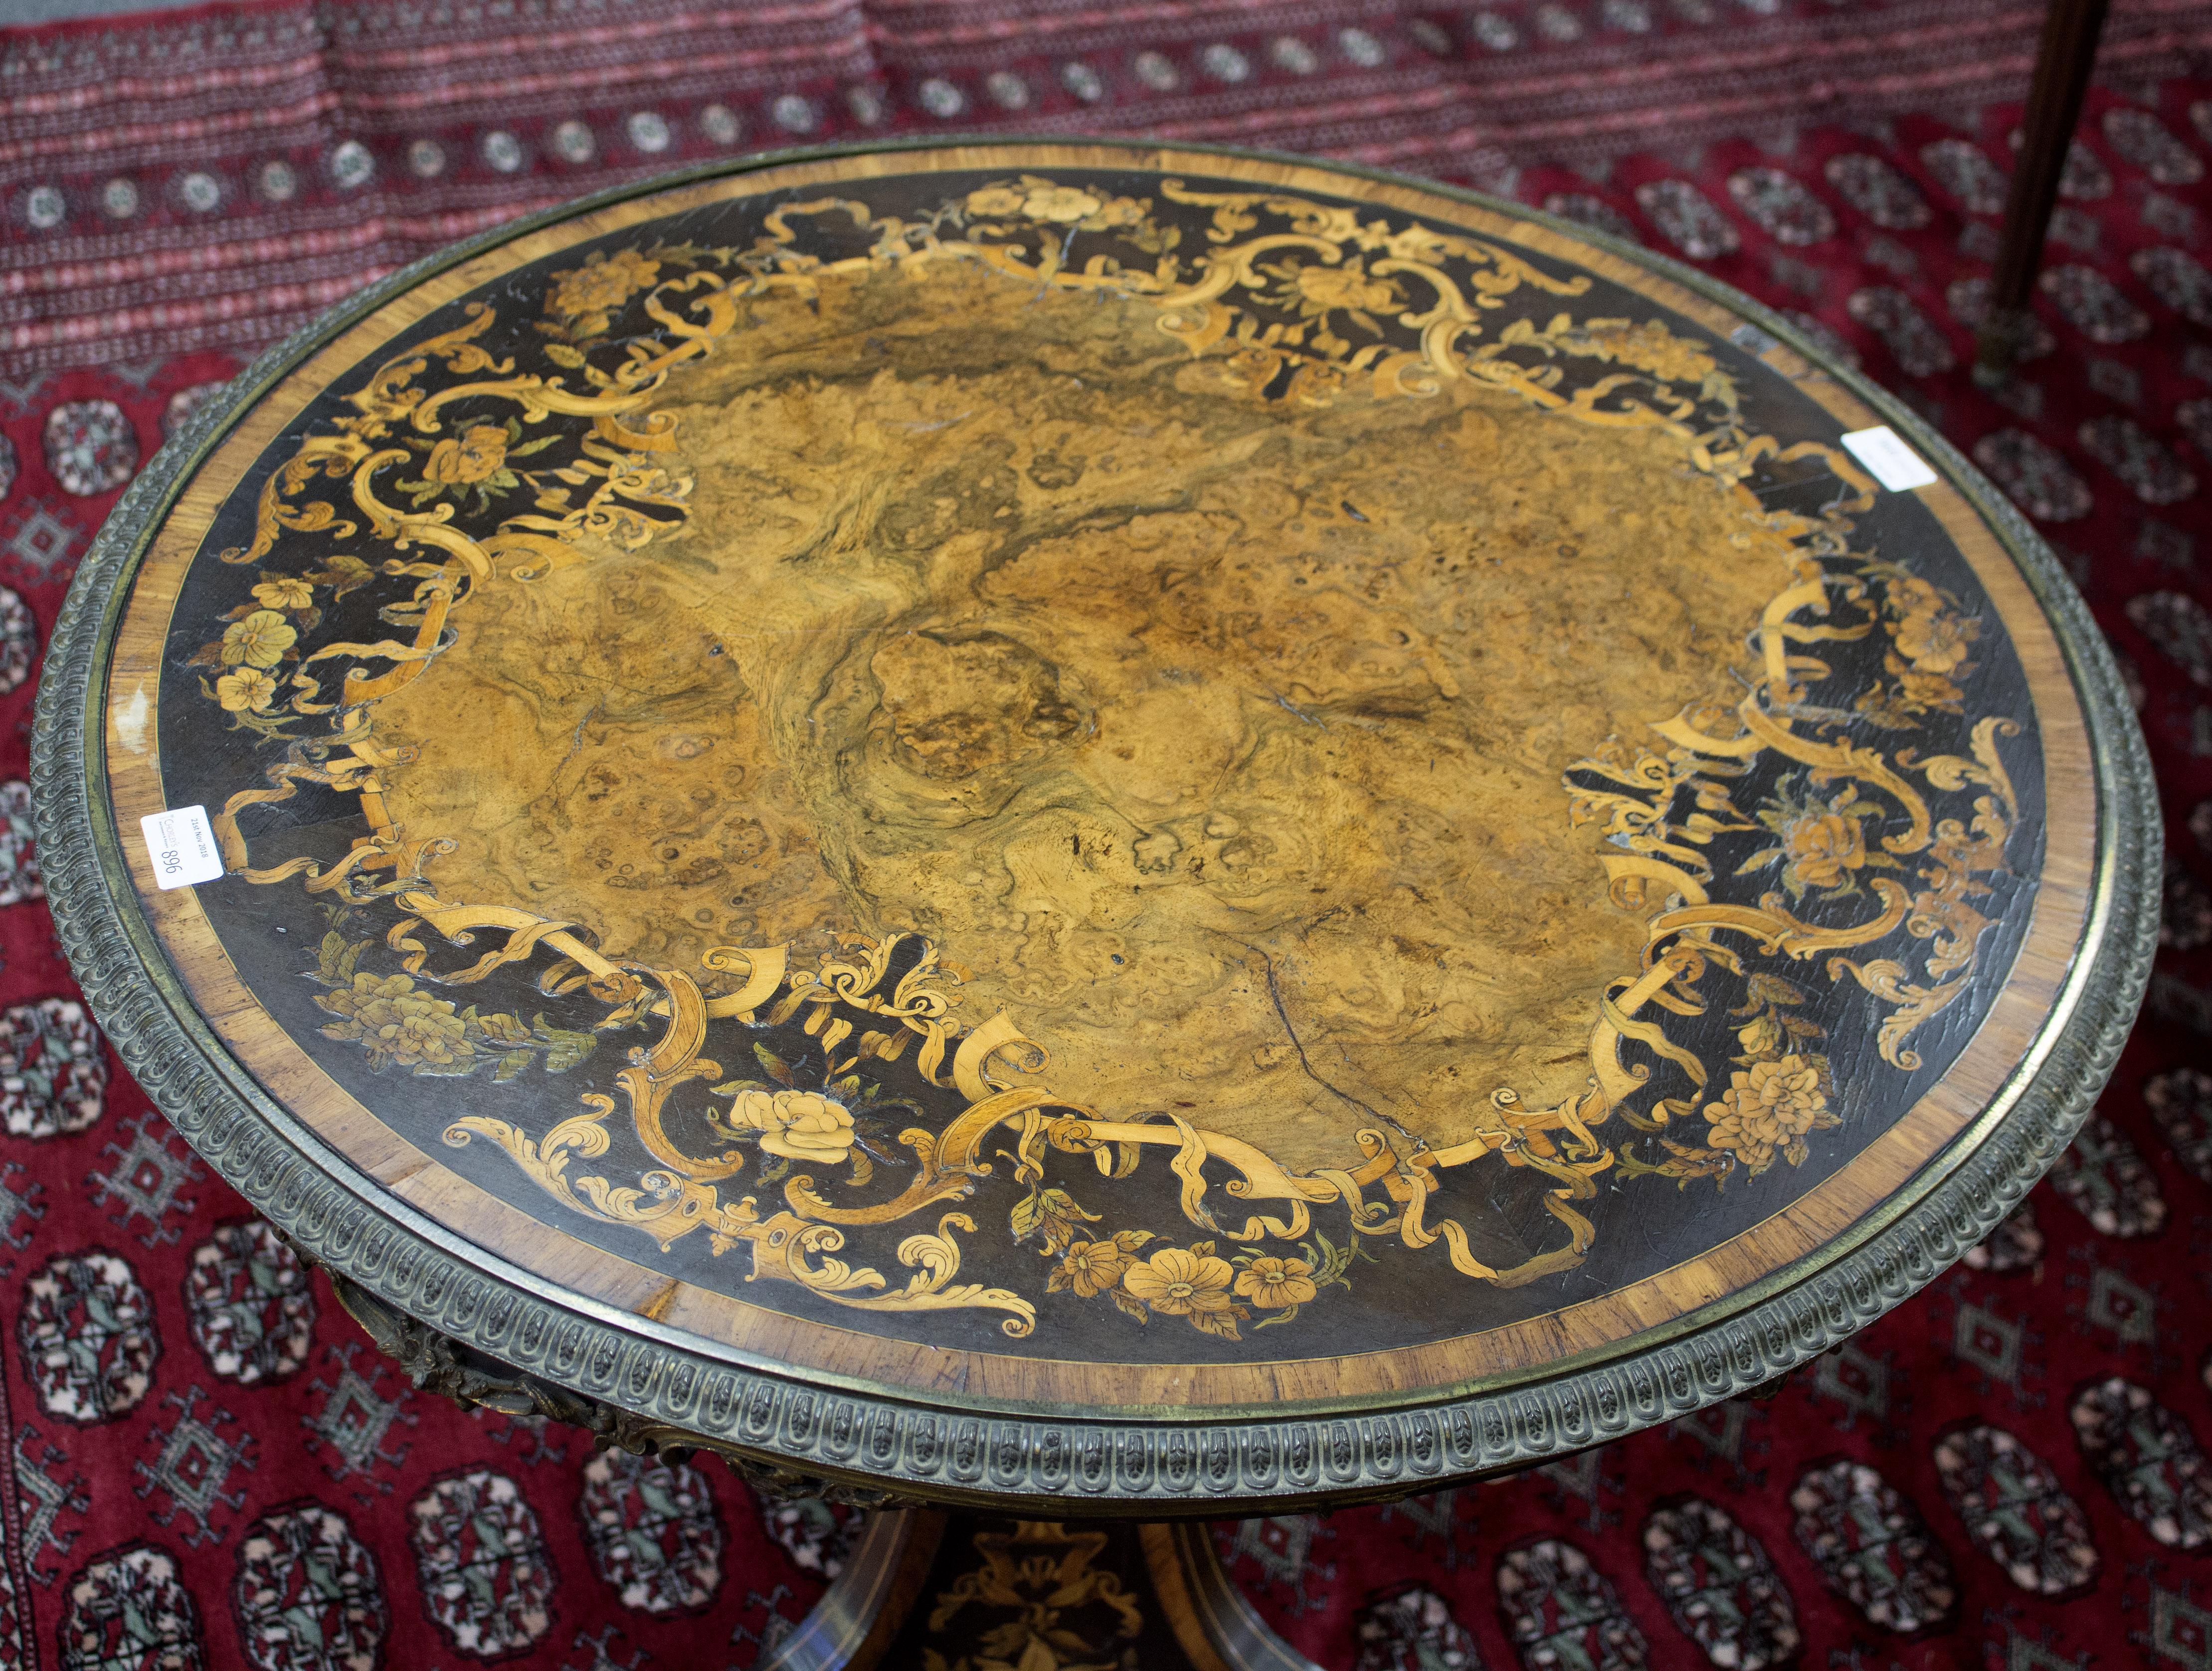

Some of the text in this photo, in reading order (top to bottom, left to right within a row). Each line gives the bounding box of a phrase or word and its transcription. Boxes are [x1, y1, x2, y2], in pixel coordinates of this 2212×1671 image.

[191, 818, 200, 831] 21st
[198, 843, 208, 858] 2018
[162, 850, 183, 873] 896
